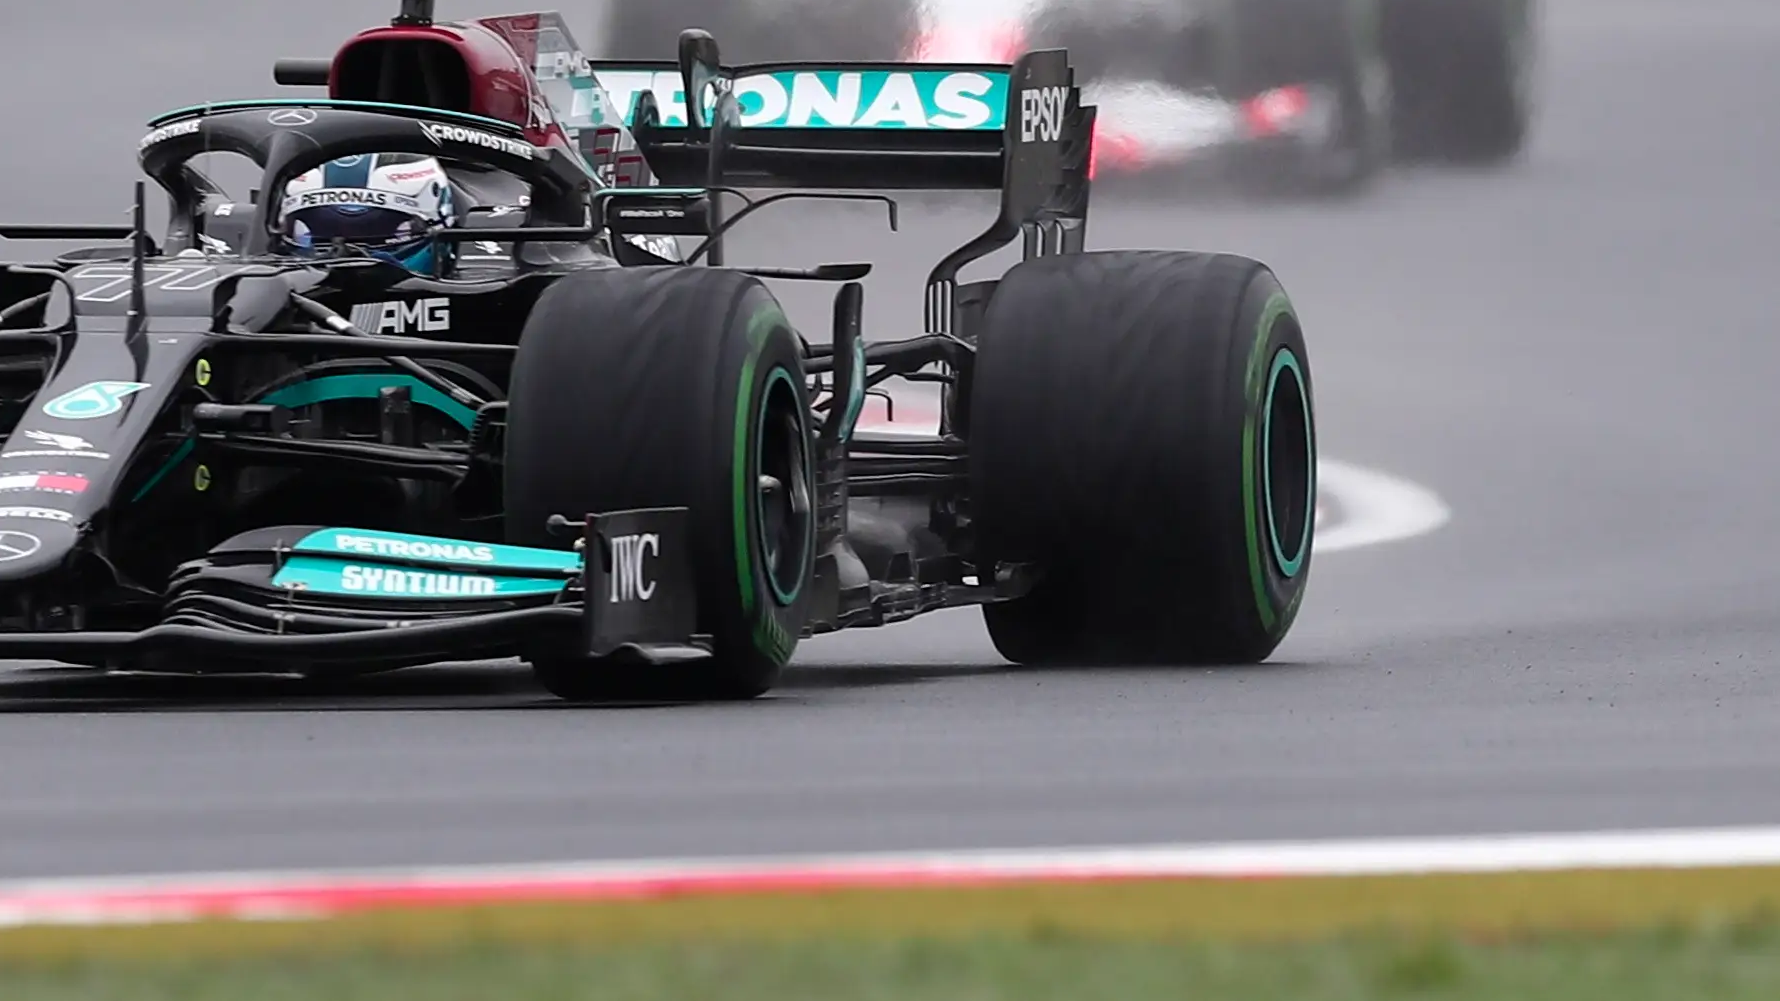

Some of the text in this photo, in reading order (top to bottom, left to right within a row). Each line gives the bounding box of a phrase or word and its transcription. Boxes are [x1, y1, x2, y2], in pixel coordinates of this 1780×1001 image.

[300, 191, 386, 205] PETRONAS
[377, 297, 450, 334] AMG
[335, 534, 494, 561] PETRONAS
[610, 533, 659, 603] IWC
